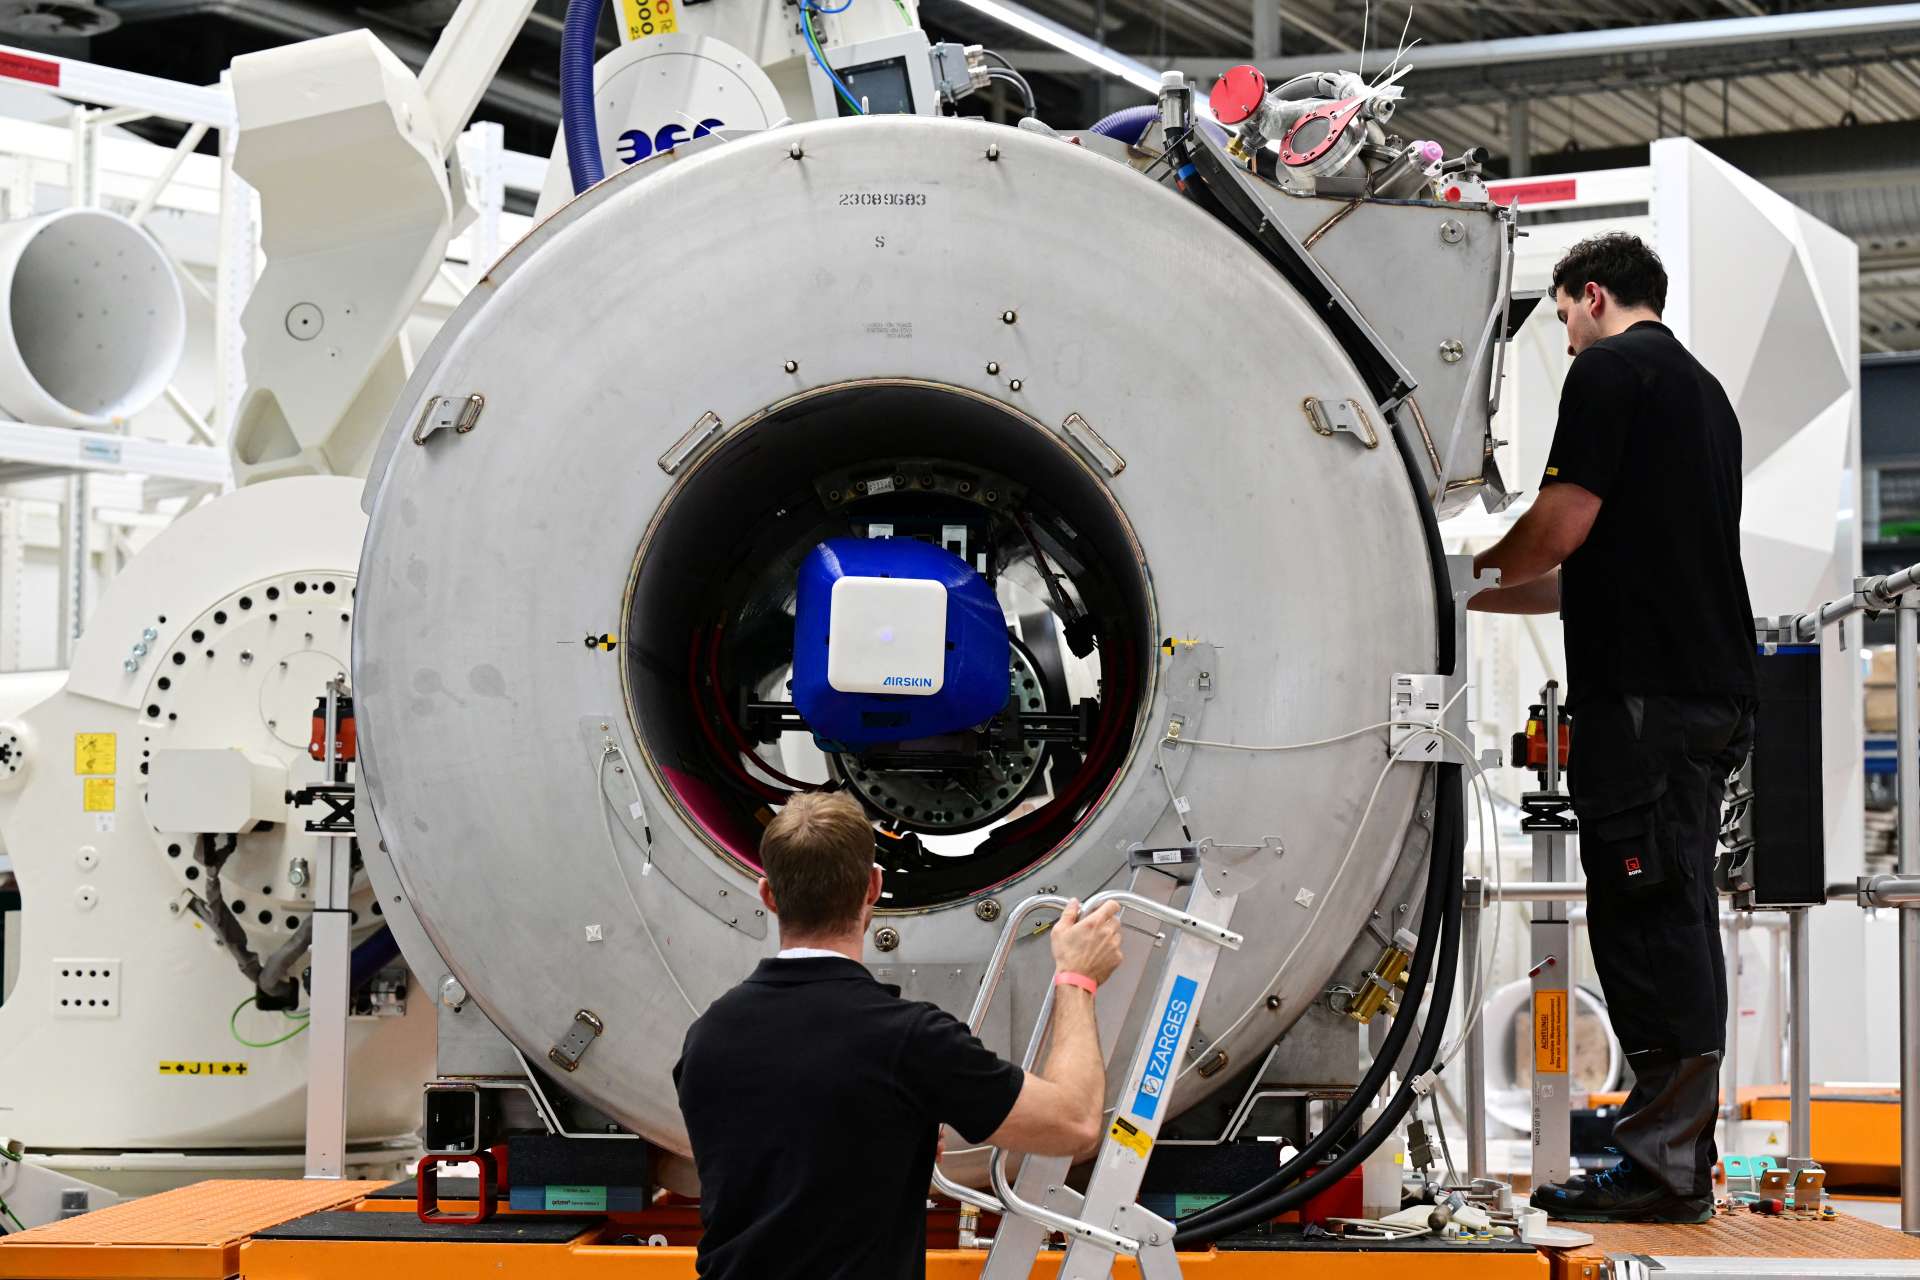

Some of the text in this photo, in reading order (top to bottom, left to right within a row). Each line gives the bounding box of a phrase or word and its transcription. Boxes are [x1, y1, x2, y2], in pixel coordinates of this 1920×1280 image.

[839, 193, 926, 206] 23089683
[875, 235, 885, 248] S
[883, 676, 932, 688] AIRSKIN
[1150, 1000, 1188, 1076] ZARGES
